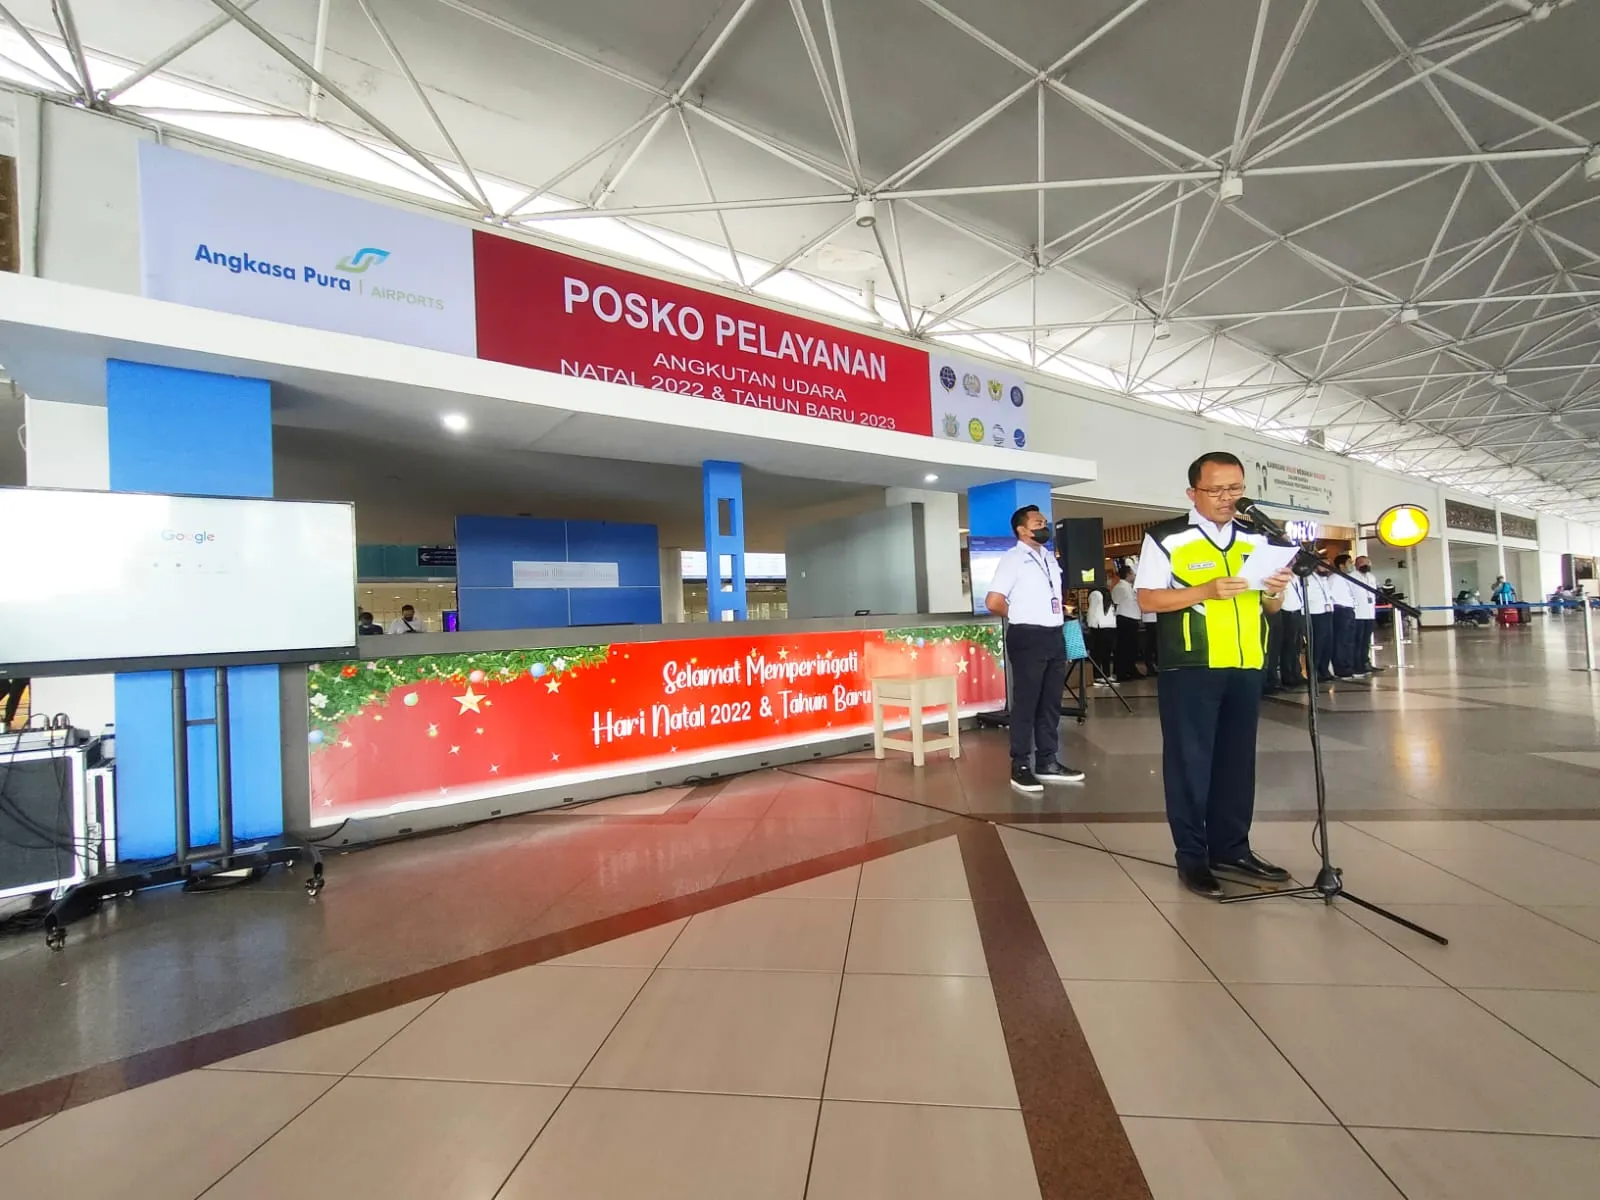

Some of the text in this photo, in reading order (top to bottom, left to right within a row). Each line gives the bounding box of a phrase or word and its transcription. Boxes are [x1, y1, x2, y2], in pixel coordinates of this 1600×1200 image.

[194, 243, 350, 291] Angkasa Pura
[371, 285, 445, 311] AIRPORTS
[563, 276, 704, 341] POSKO
[716, 314, 886, 382] PELAYANAN
[560, 359, 896, 430] NATAL 2022 & TAHUN BARU 2023
[653, 352, 847, 402] ANGKUTAN UDARA
[663, 653, 858, 694] Selamat Memperingati
[592, 685, 873, 746] Hari Natal 2022 & Tahun Baru
